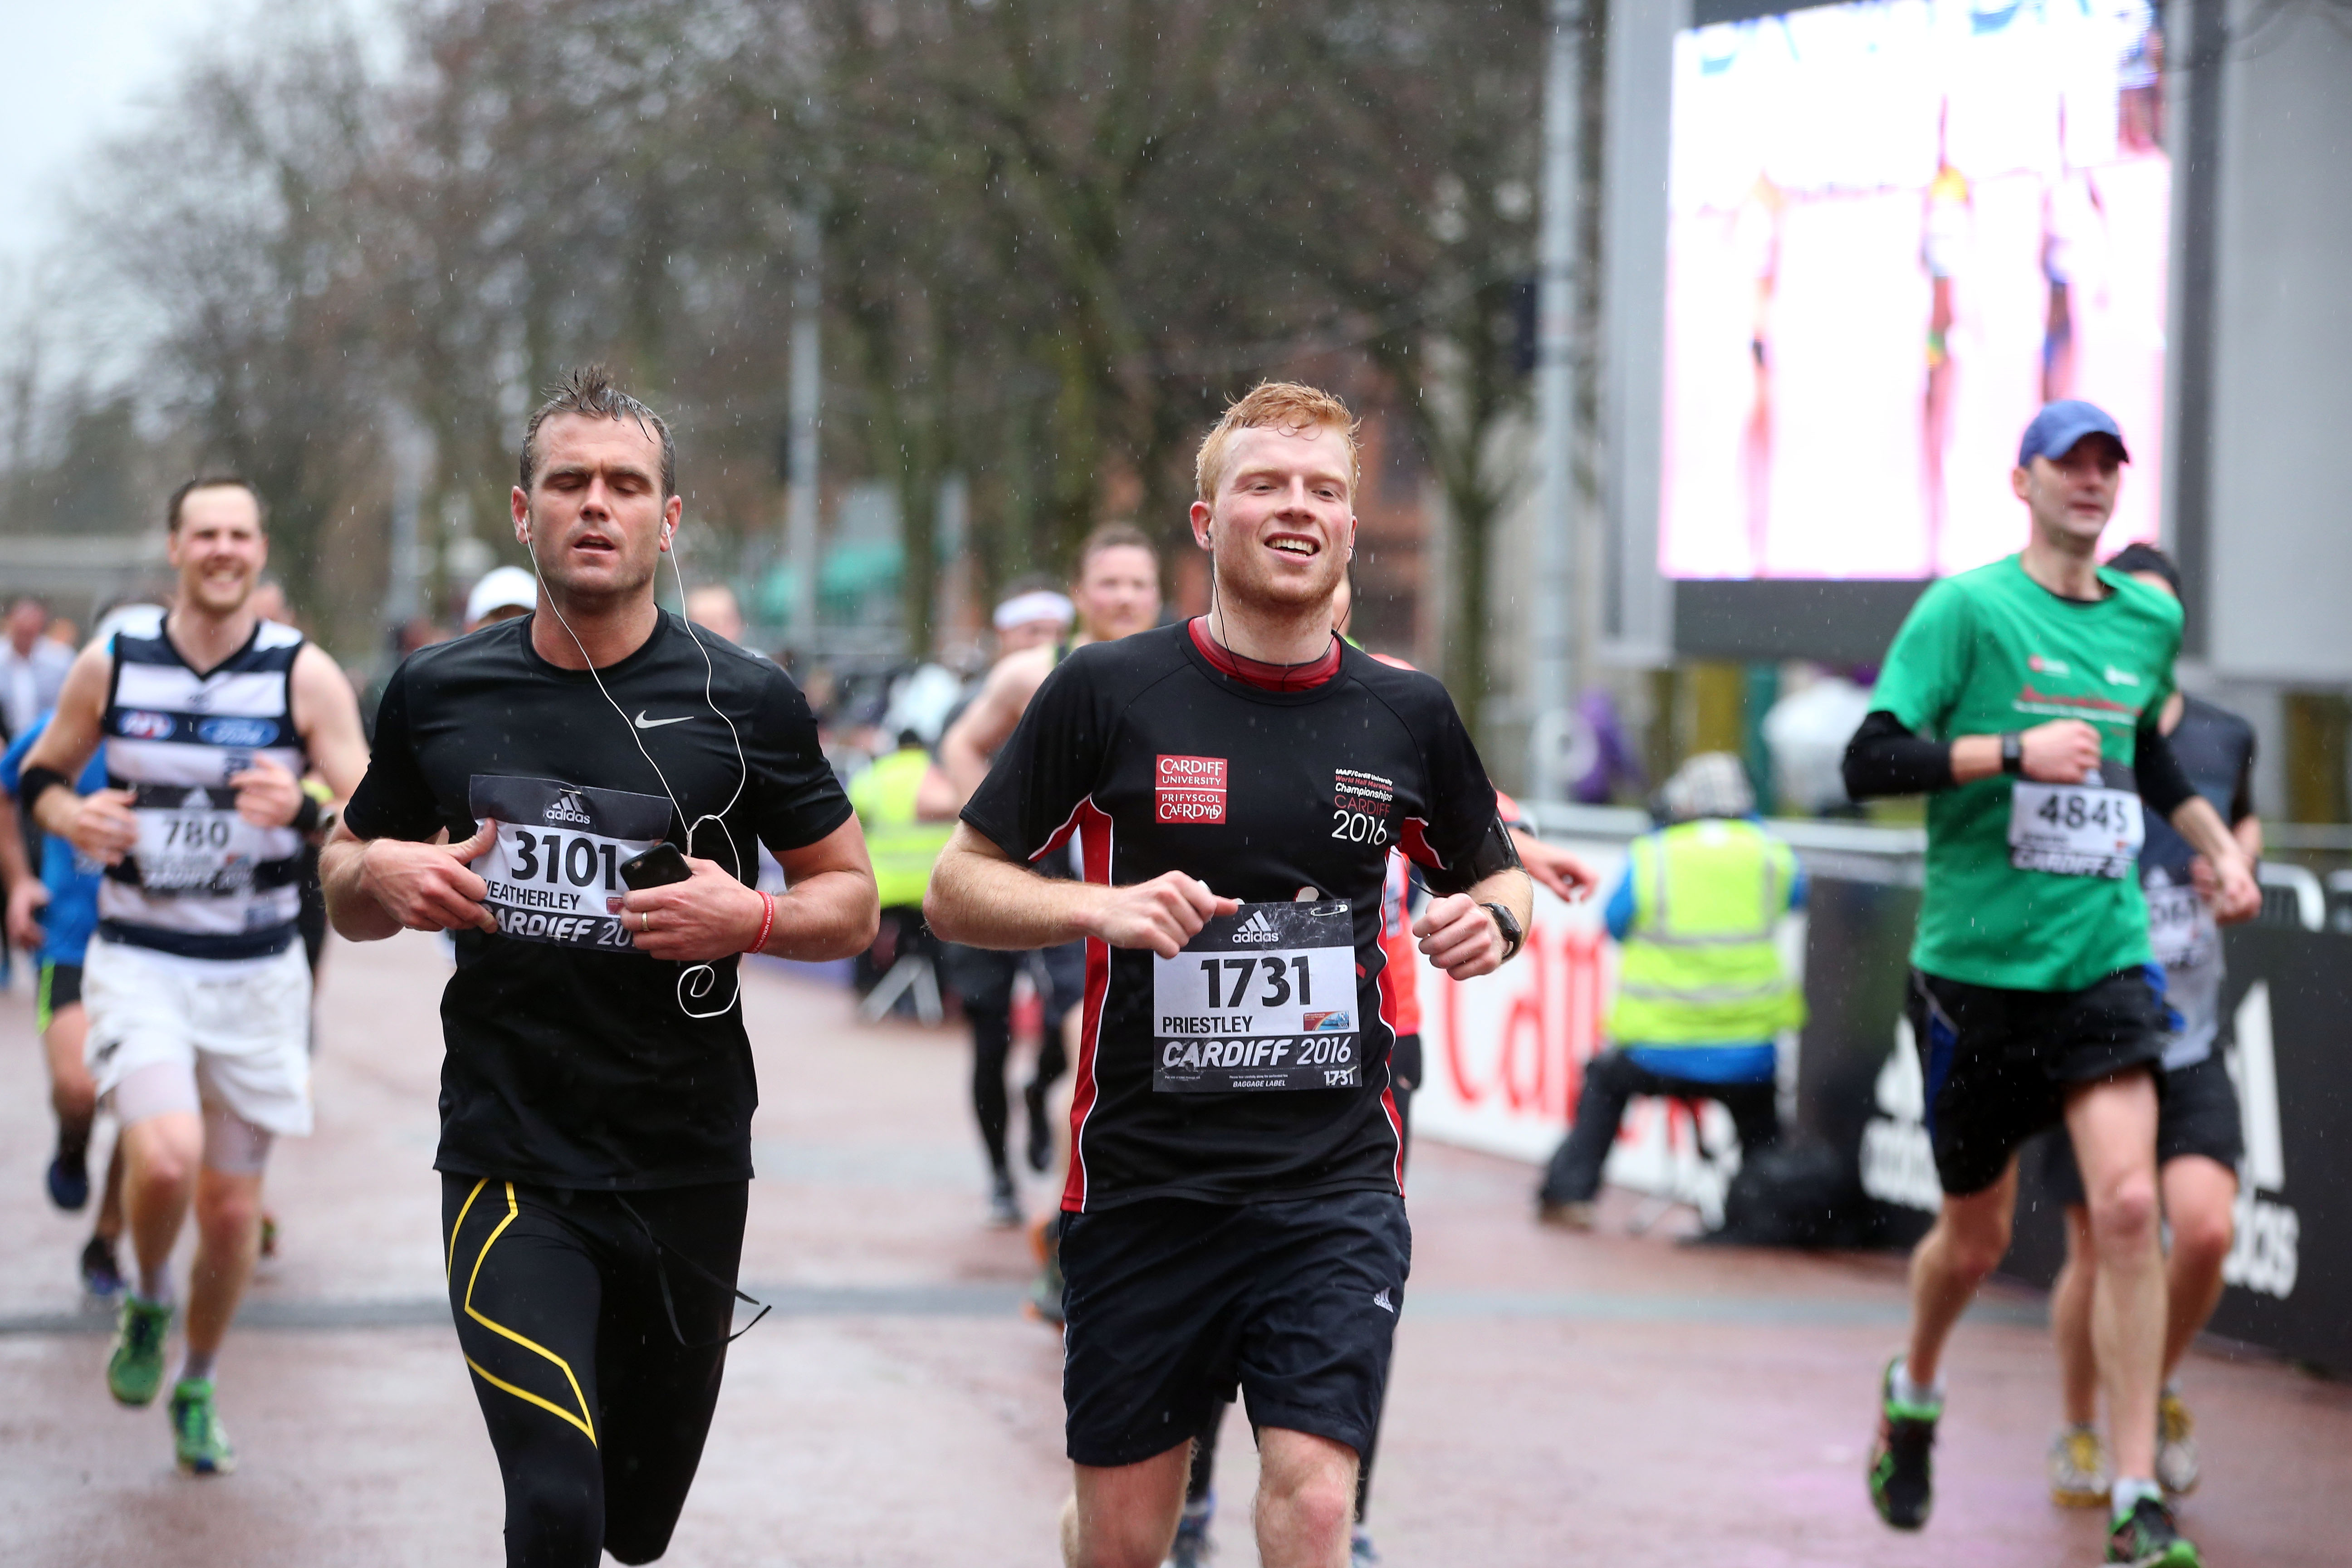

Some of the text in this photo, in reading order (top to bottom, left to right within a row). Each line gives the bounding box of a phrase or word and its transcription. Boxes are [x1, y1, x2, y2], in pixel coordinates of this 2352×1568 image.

[1160, 758, 1224, 776] CARDIFF
[1162, 775, 1221, 785] UNIVERSITY
[1335, 775, 1393, 792] World Half Marathon
[1371, 774, 1393, 786] University
[1162, 794, 1220, 803] PRIFYSGOL
[1335, 782, 1393, 802] Championships
[1334, 794, 1391, 818] CARDIFF
[2038, 794, 2127, 833] 4845
[546, 808, 590, 824] adidas
[162, 819, 230, 848] 780
[1332, 809, 1387, 846] 2016
[511, 830, 617, 891] 3101
[597, 921, 635, 947] 20
[1232, 930, 1279, 944] adidas
[1200, 955, 1311, 1009] 1731
[1162, 1015, 1253, 1034] PRIESTLEY
[1162, 1036, 1352, 1068] CARDIFF 2016
[1323, 1069, 1354, 1086] 1731
